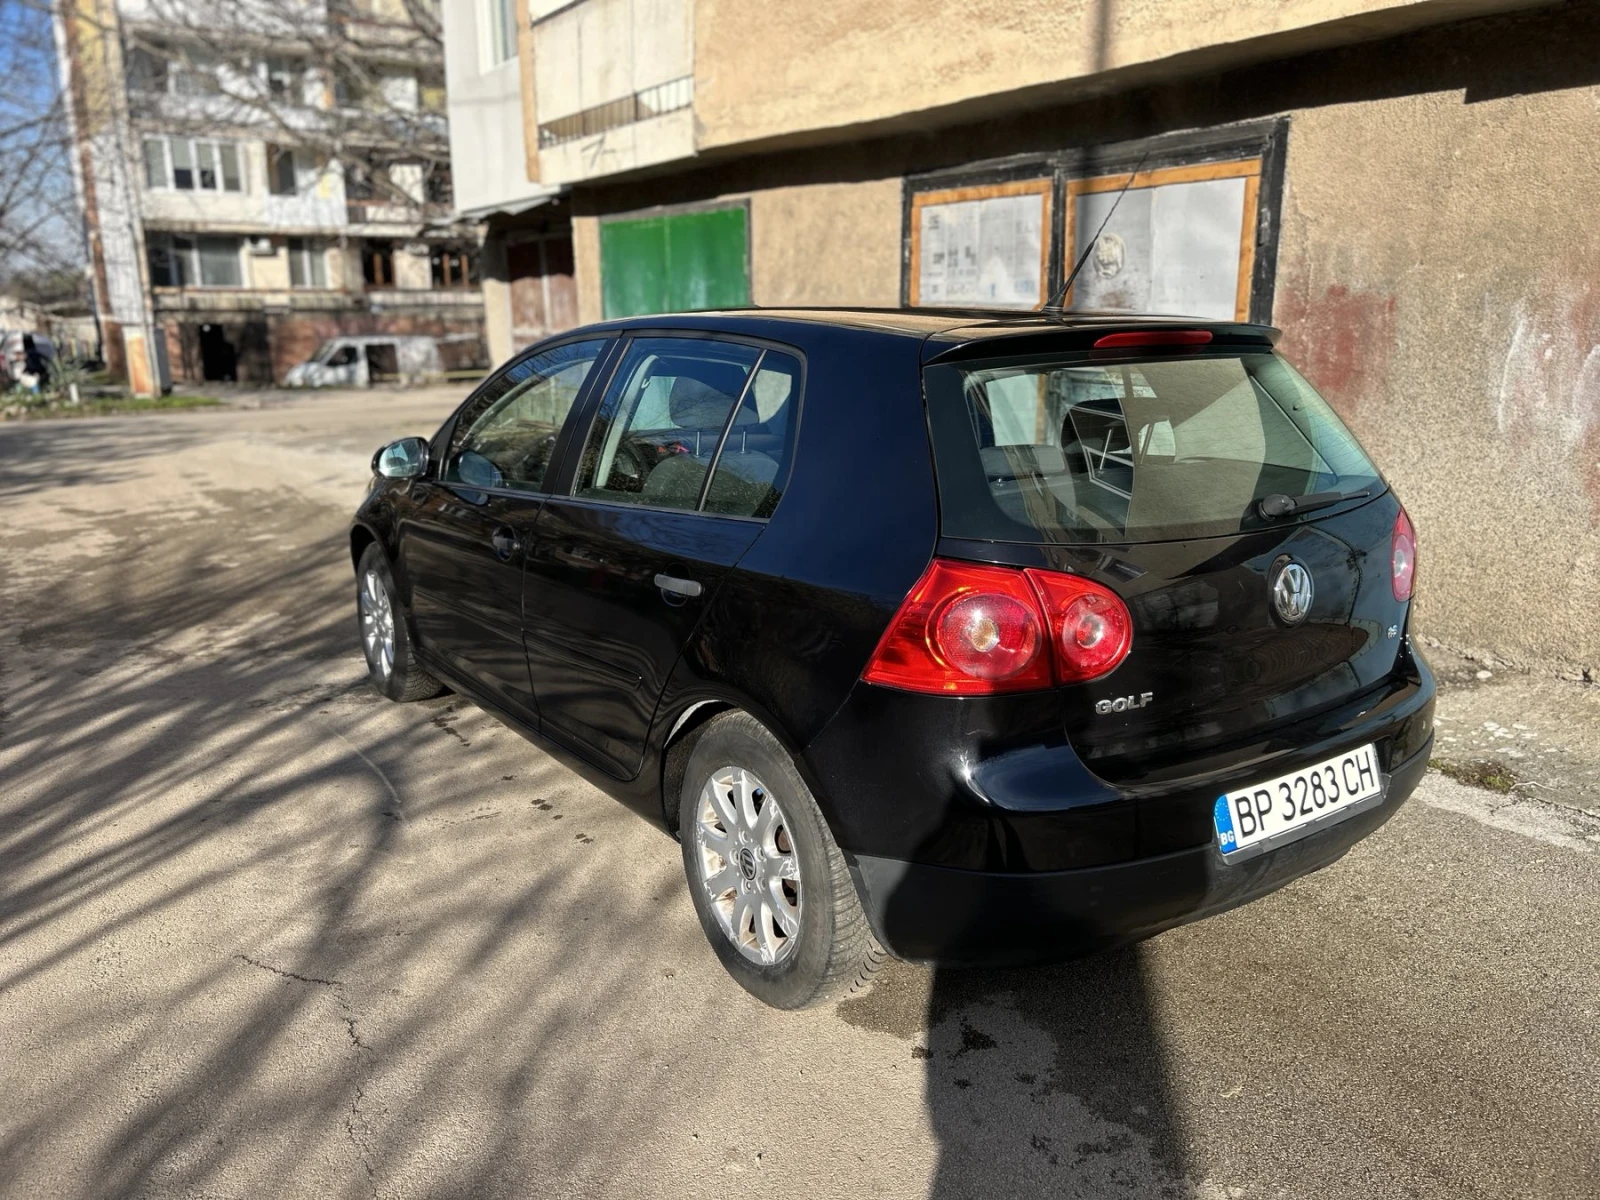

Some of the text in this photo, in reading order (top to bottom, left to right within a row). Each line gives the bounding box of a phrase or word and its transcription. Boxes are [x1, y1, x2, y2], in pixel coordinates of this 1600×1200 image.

[1095, 692, 1153, 715] GOLF
[1235, 751, 1375, 839] BP 3283 CH
[1220, 832, 1234, 845] BG
